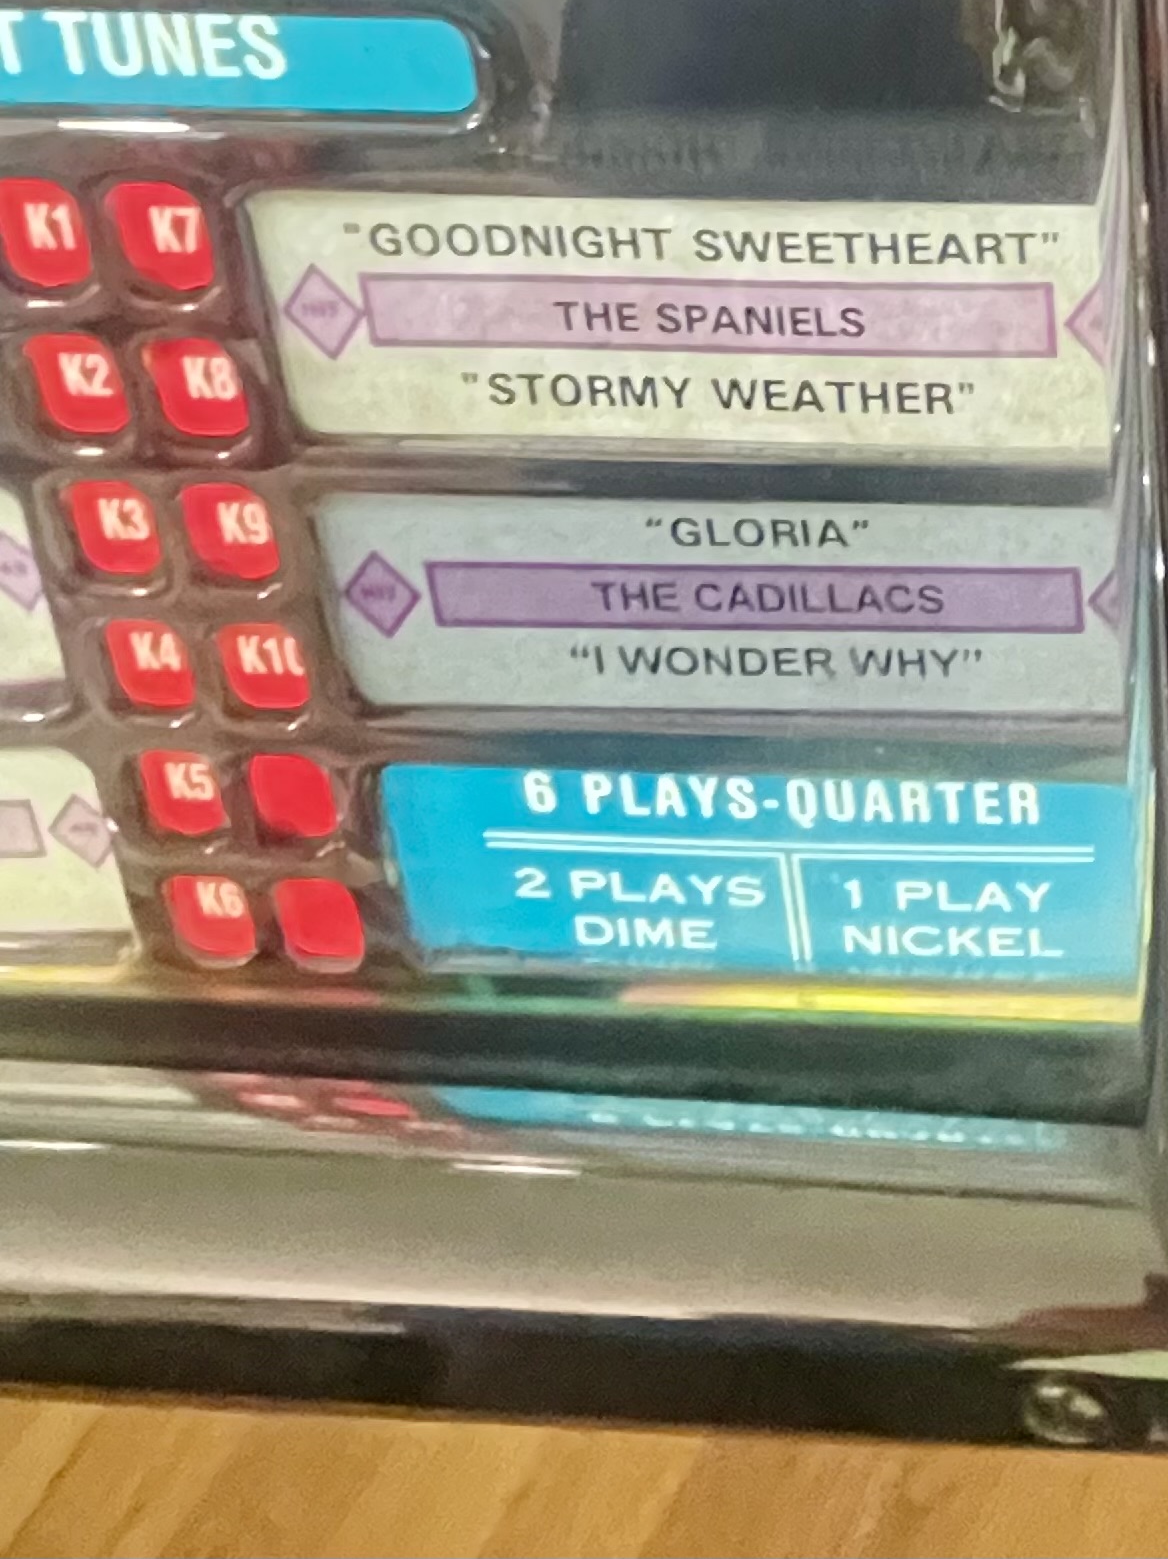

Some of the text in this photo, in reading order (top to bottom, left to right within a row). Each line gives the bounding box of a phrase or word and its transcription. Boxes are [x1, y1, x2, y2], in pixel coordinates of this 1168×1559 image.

[0, 11, 287, 80] T TUNES
[24, 203, 76, 251] K1
[148, 205, 200, 254] K7
[343, 222, 1058, 265] "GOODNIGHT SWEETHEART"
[552, 301, 866, 339] THE SPANIELS
[57, 351, 115, 397] K2
[182, 355, 237, 400] K8
[463, 373, 974, 415] "STORMY WEATHER"
[98, 498, 150, 541] K3
[217, 502, 268, 545] K9
[646, 517, 869, 548] "GLORIA"
[591, 581, 945, 615] THE CADILLACS
[129, 632, 182, 672] K4
[570, 645, 982, 678] "I WONDER WHY"
[164, 762, 216, 801] K5
[522, 771, 1040, 828] 6 PLAYS-QUARTER
[196, 880, 246, 920] K6
[514, 866, 766, 908] 2 PLAYS
[843, 879, 1052, 914] 1 PLAY
[574, 915, 718, 950] DIME
[843, 923, 1066, 959] NICKEL
